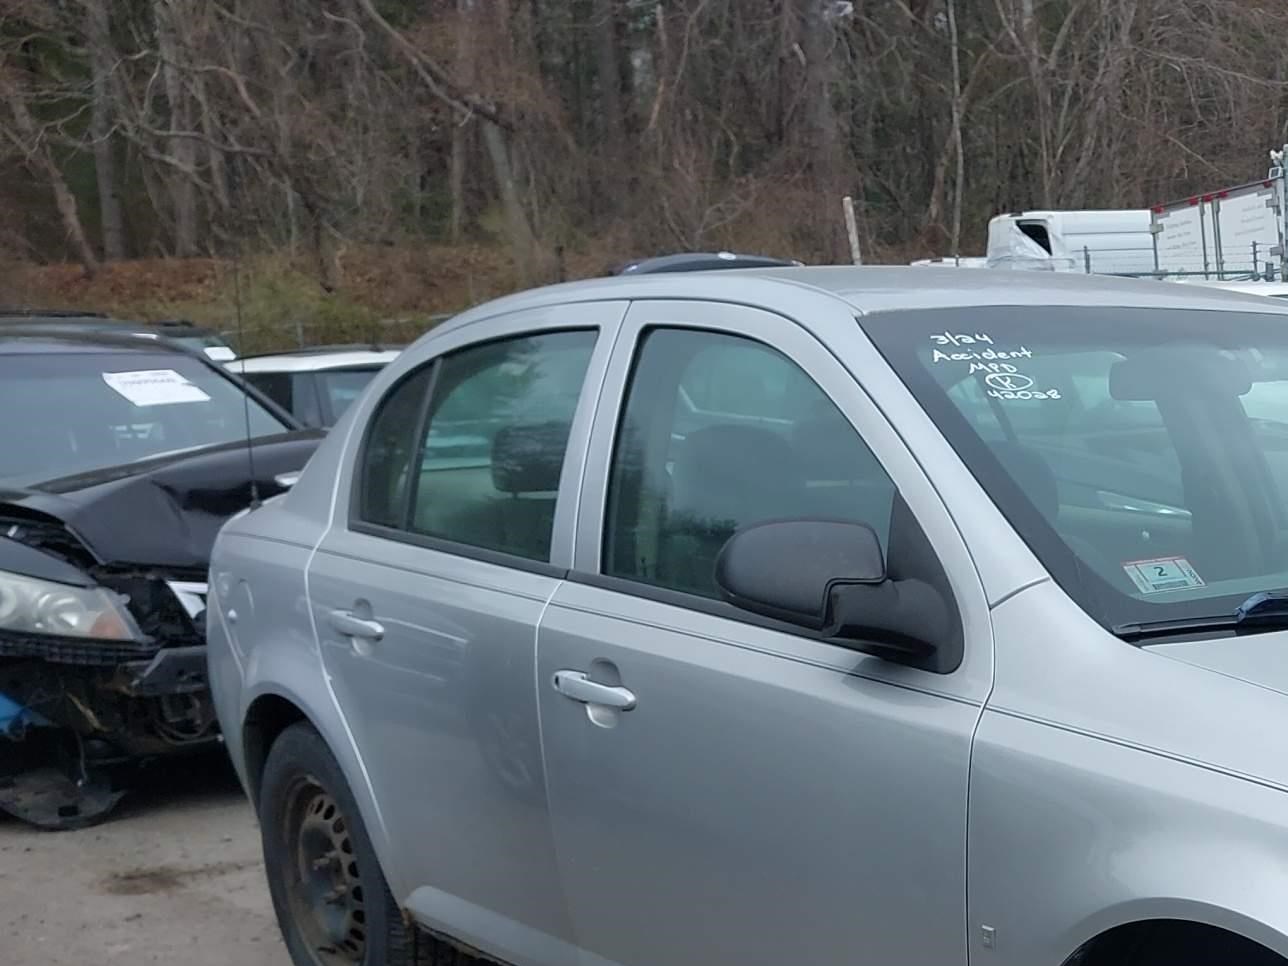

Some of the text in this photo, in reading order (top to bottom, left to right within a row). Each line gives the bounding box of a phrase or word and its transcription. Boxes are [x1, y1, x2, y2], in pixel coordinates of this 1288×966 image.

[930, 331, 994, 346] 3/24
[932, 347, 1032, 362] Accident
[987, 389, 1062, 400] 42028
[1153, 566, 1168, 577] 2
